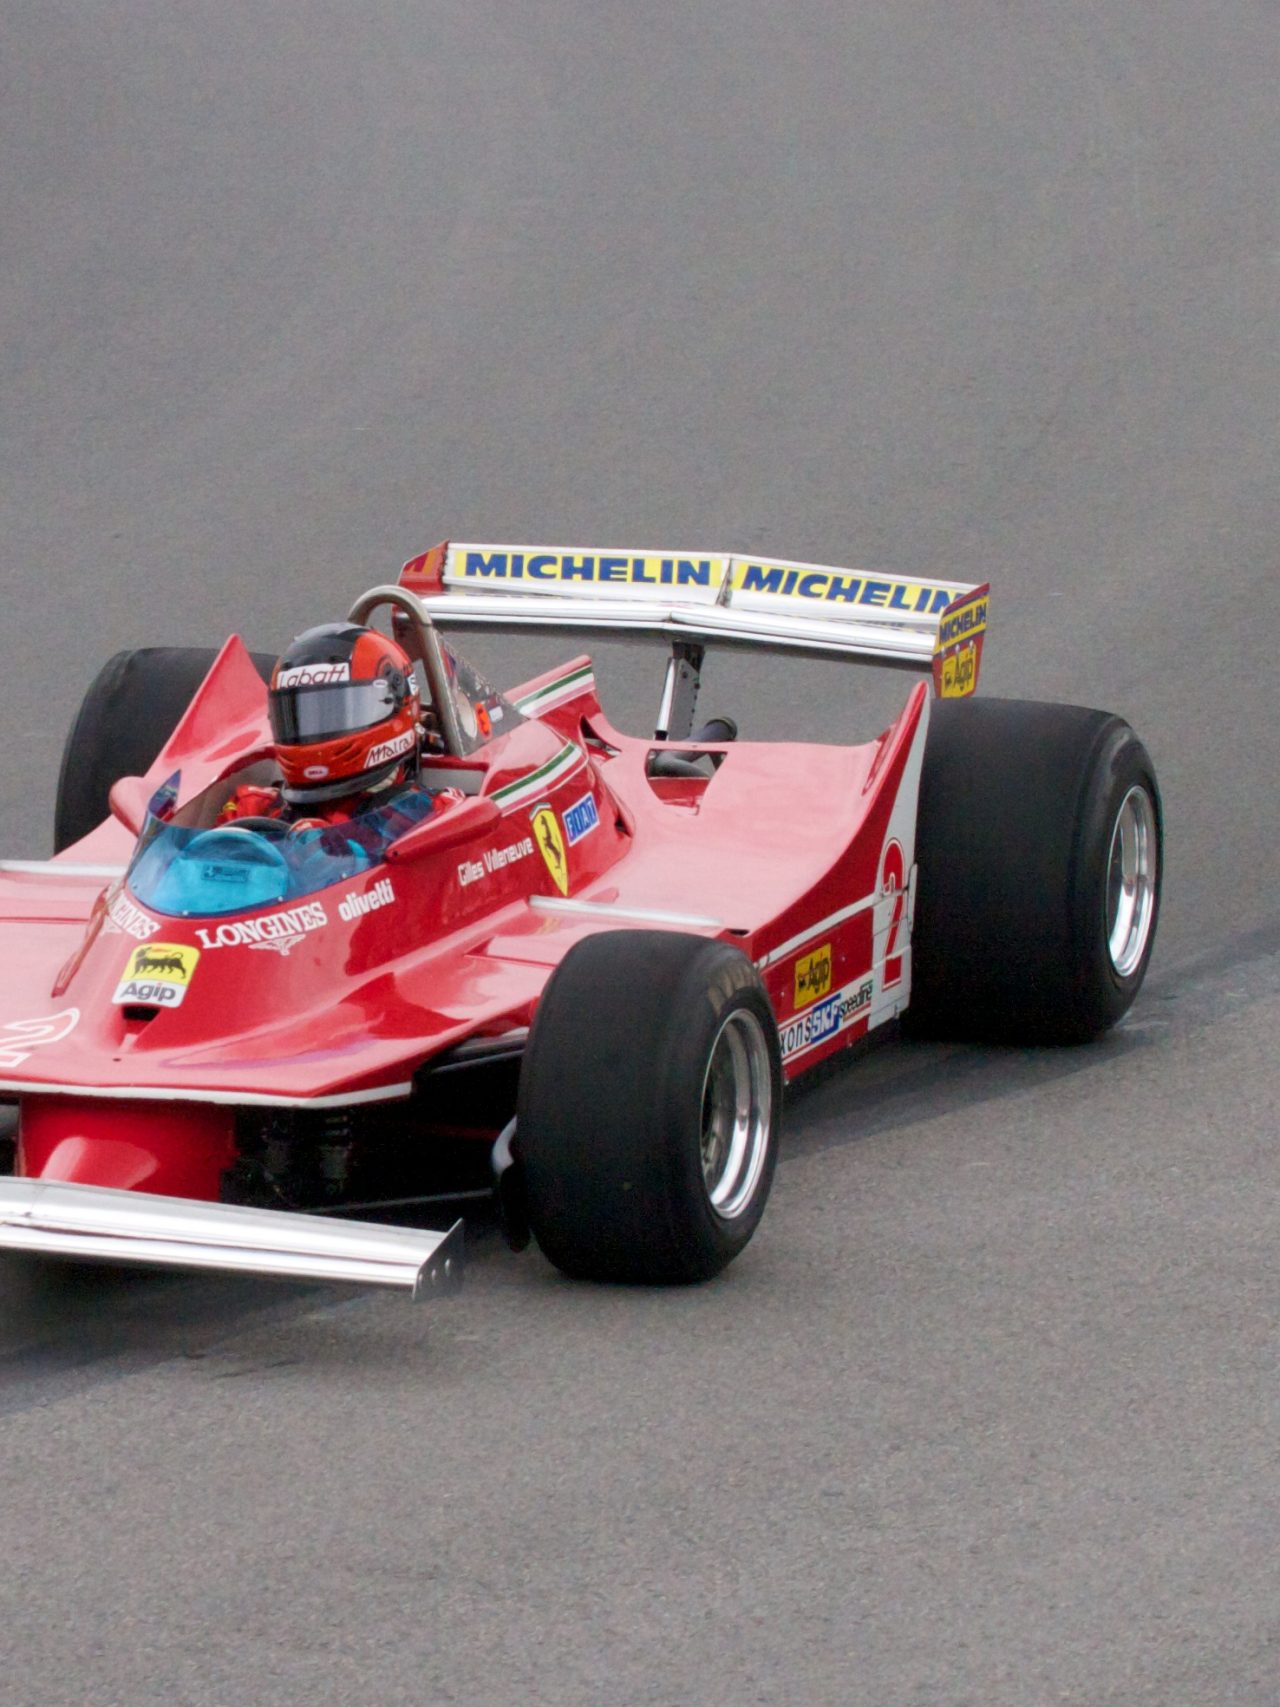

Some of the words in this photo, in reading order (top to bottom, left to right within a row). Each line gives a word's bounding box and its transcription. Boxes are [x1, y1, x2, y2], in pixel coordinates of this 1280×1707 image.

[465, 553, 710, 585] MICHELIN
[741, 565, 963, 614] MICHELIN
[939, 602, 987, 645] MICHELIN
[566, 801, 597, 840] FIAT
[458, 860, 485, 887] Gilles
[483, 837, 535, 873] Villeneuve
[338, 878, 395, 922] olivetti
[881, 837, 904, 992] 2
[195, 901, 328, 949] LONGINES
[120, 982, 176, 1001] Agip
[806, 958, 829, 994] Agip
[810, 998, 839, 1038] SKF
